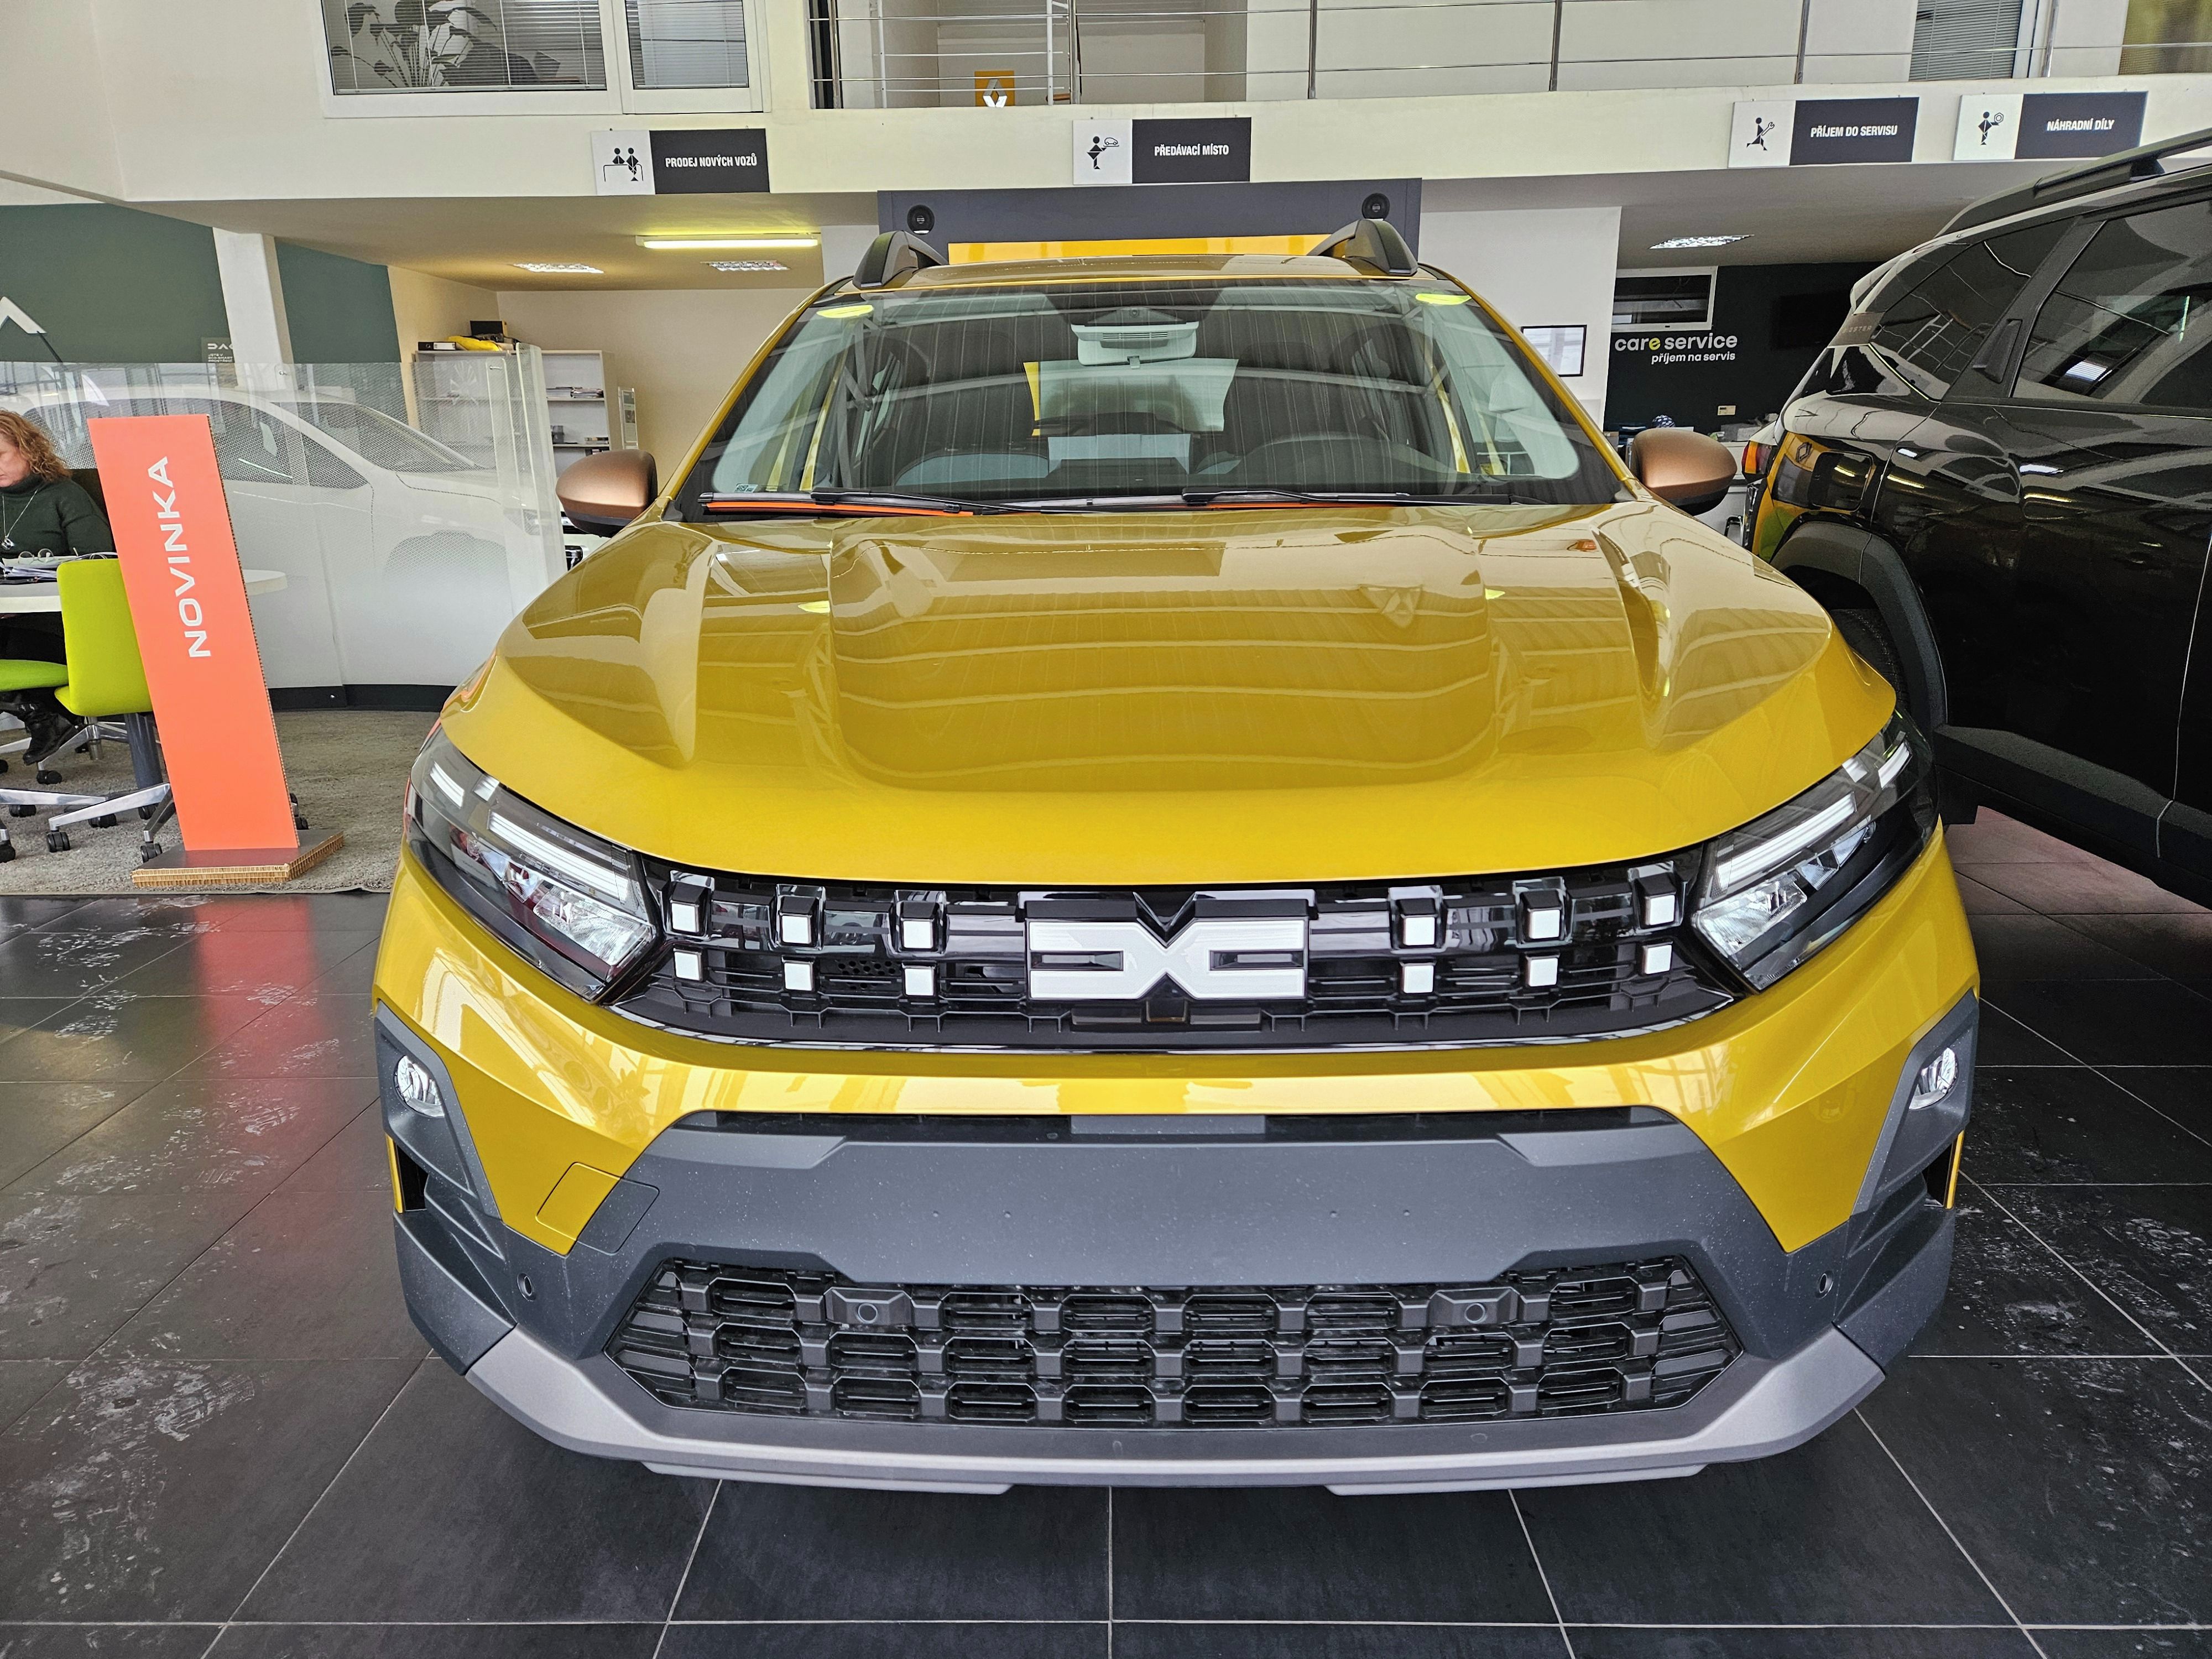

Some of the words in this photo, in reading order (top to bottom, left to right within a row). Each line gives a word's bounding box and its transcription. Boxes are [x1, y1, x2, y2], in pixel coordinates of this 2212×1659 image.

[2047, 118, 2093, 131] NÁHRADNÍ
[2094, 119, 2115, 131] DÍLY
[1811, 125, 1843, 138] PŘÍJEM
[1845, 127, 1859, 137] DO
[1860, 125, 1898, 136] SERVISU
[1154, 143, 1200, 156] PŘEDÁVACÍ
[1202, 143, 1229, 155] MÍSTO
[665, 155, 698, 168] PRODEJ
[700, 154, 733, 167] NOVÝCH
[734, 152, 757, 166] VOZŮ
[1615, 335, 1661, 351] care
[1664, 332, 1738, 350] service
[1651, 353, 1686, 364] příjem
[1688, 354, 1702, 362] na
[1703, 351, 1735, 362] servis
[148, 456, 211, 658] NOVINKA
